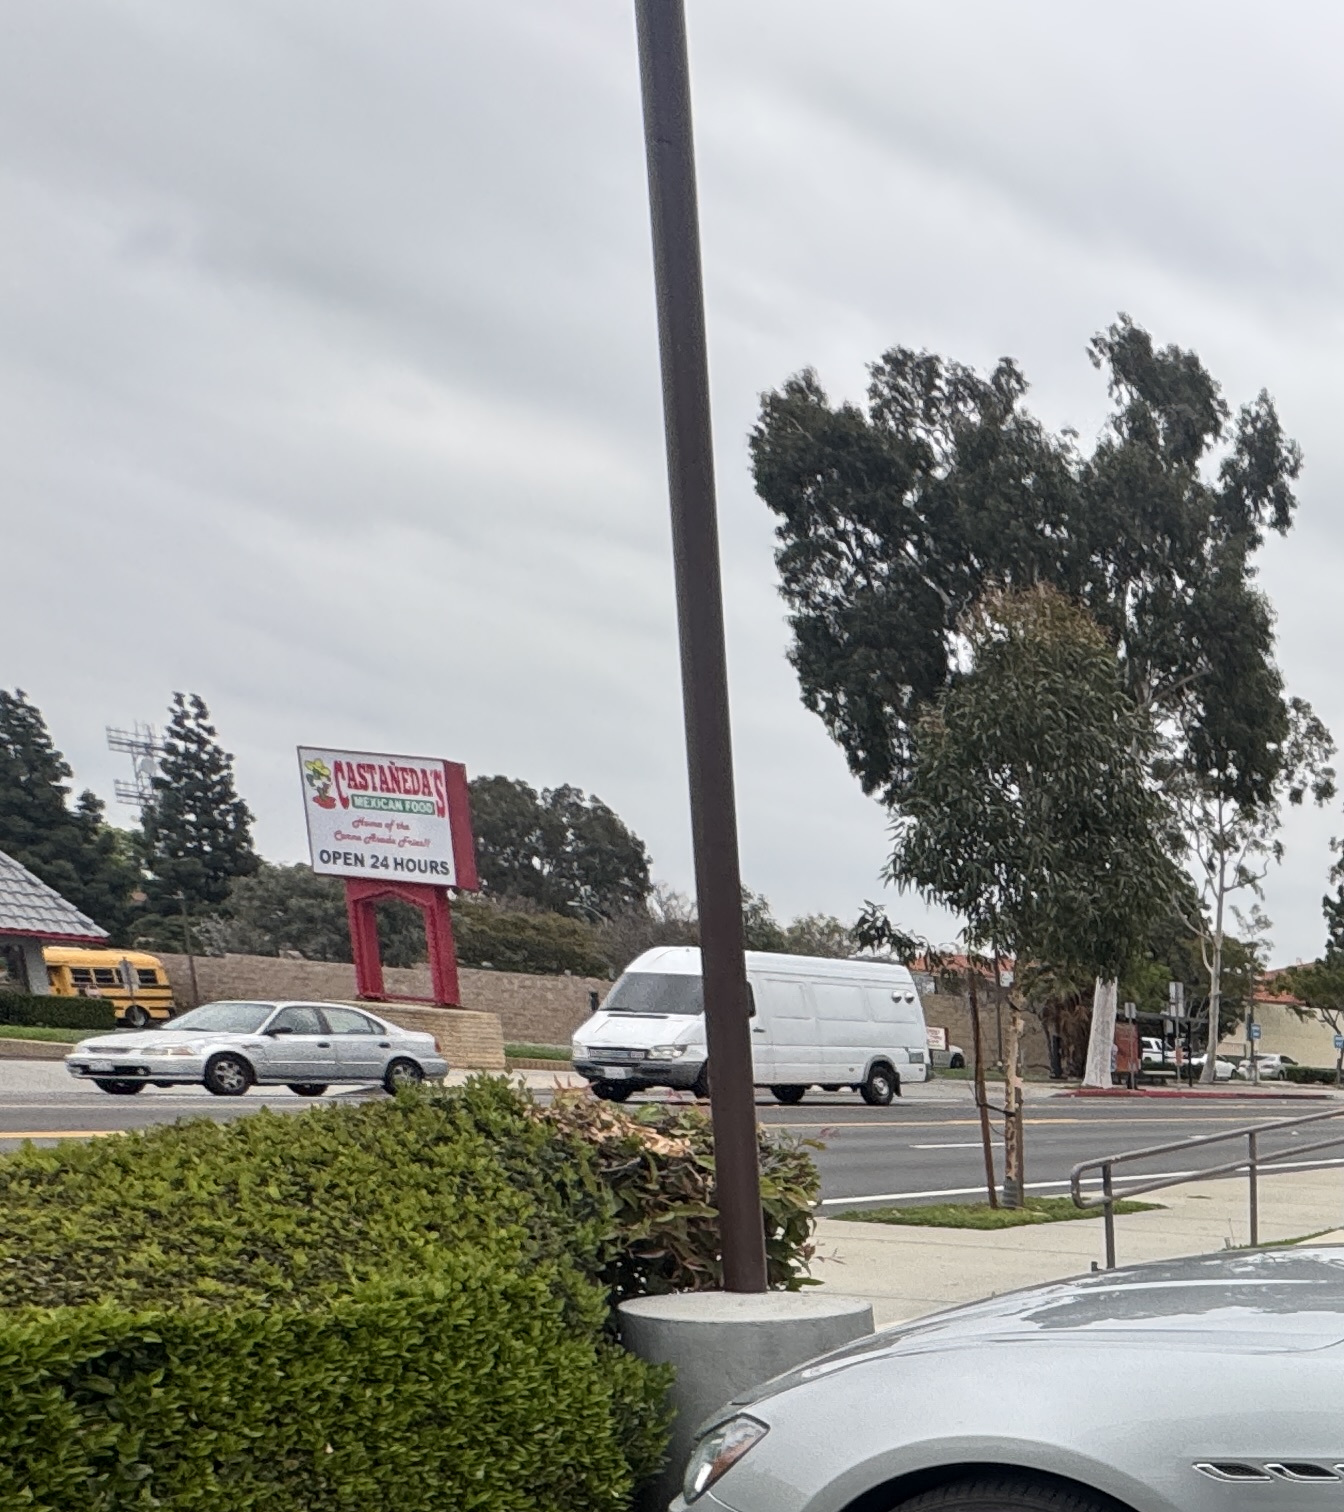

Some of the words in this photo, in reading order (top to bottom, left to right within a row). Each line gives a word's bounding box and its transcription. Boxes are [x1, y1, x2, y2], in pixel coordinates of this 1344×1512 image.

[333, 760, 446, 818] CASTAÑEDA'S
[353, 796, 404, 812] MEXICAN
[405, 802, 435, 814] FOOD
[352, 816, 382, 829] Home
[384, 819, 395, 832] of
[396, 820, 410, 831] the
[319, 850, 365, 867] OPEN
[370, 854, 390, 870] 24
[393, 857, 450, 876] HOURS
